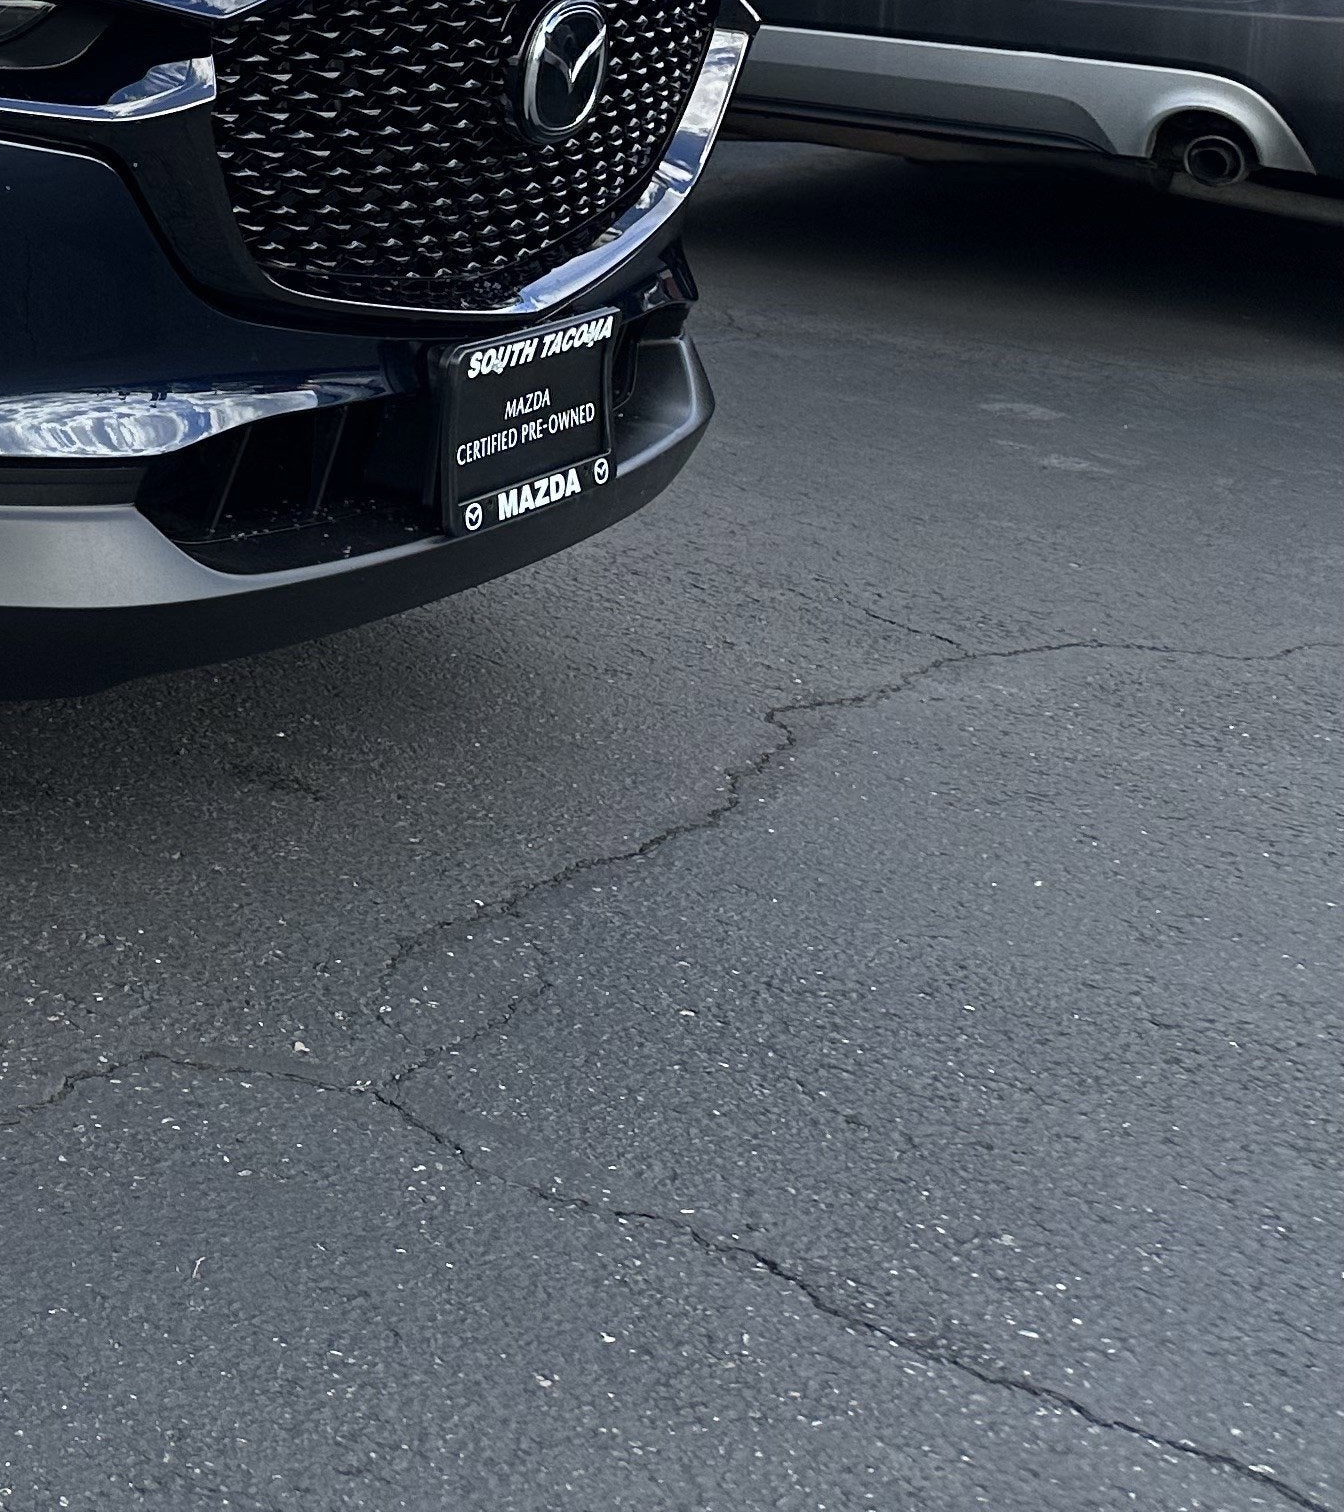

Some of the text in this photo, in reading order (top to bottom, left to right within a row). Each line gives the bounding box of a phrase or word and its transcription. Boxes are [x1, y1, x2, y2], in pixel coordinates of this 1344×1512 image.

[467, 316, 614, 378] SOUTH TACOMA
[504, 388, 551, 420] MAZDA
[456, 402, 596, 466] CERTIFIED PRE-OWNED
[497, 468, 582, 522] MAZDA
